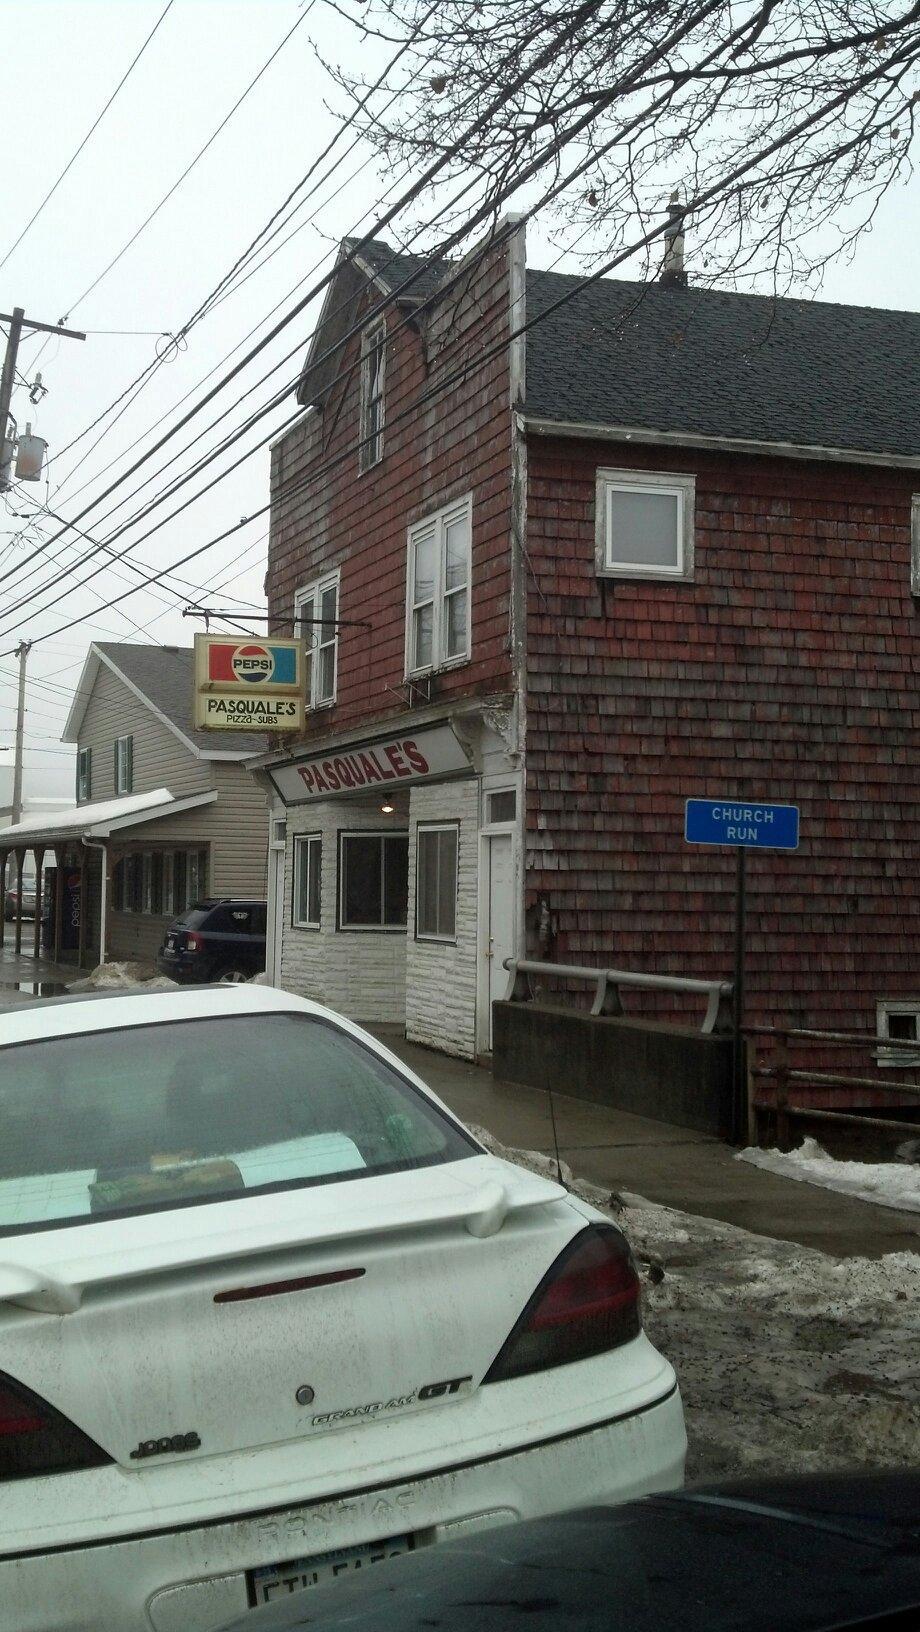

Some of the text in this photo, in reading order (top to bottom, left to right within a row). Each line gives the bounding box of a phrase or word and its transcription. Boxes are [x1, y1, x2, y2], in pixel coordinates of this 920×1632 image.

[233, 659, 272, 669] PEPSI
[208, 699, 296, 716] PASQUALE'S
[297, 740, 430, 793] PASQUALE'S
[712, 807, 774, 823] CHURCH
[727, 826, 758, 840] RUN
[418, 1374, 473, 1401] GT
